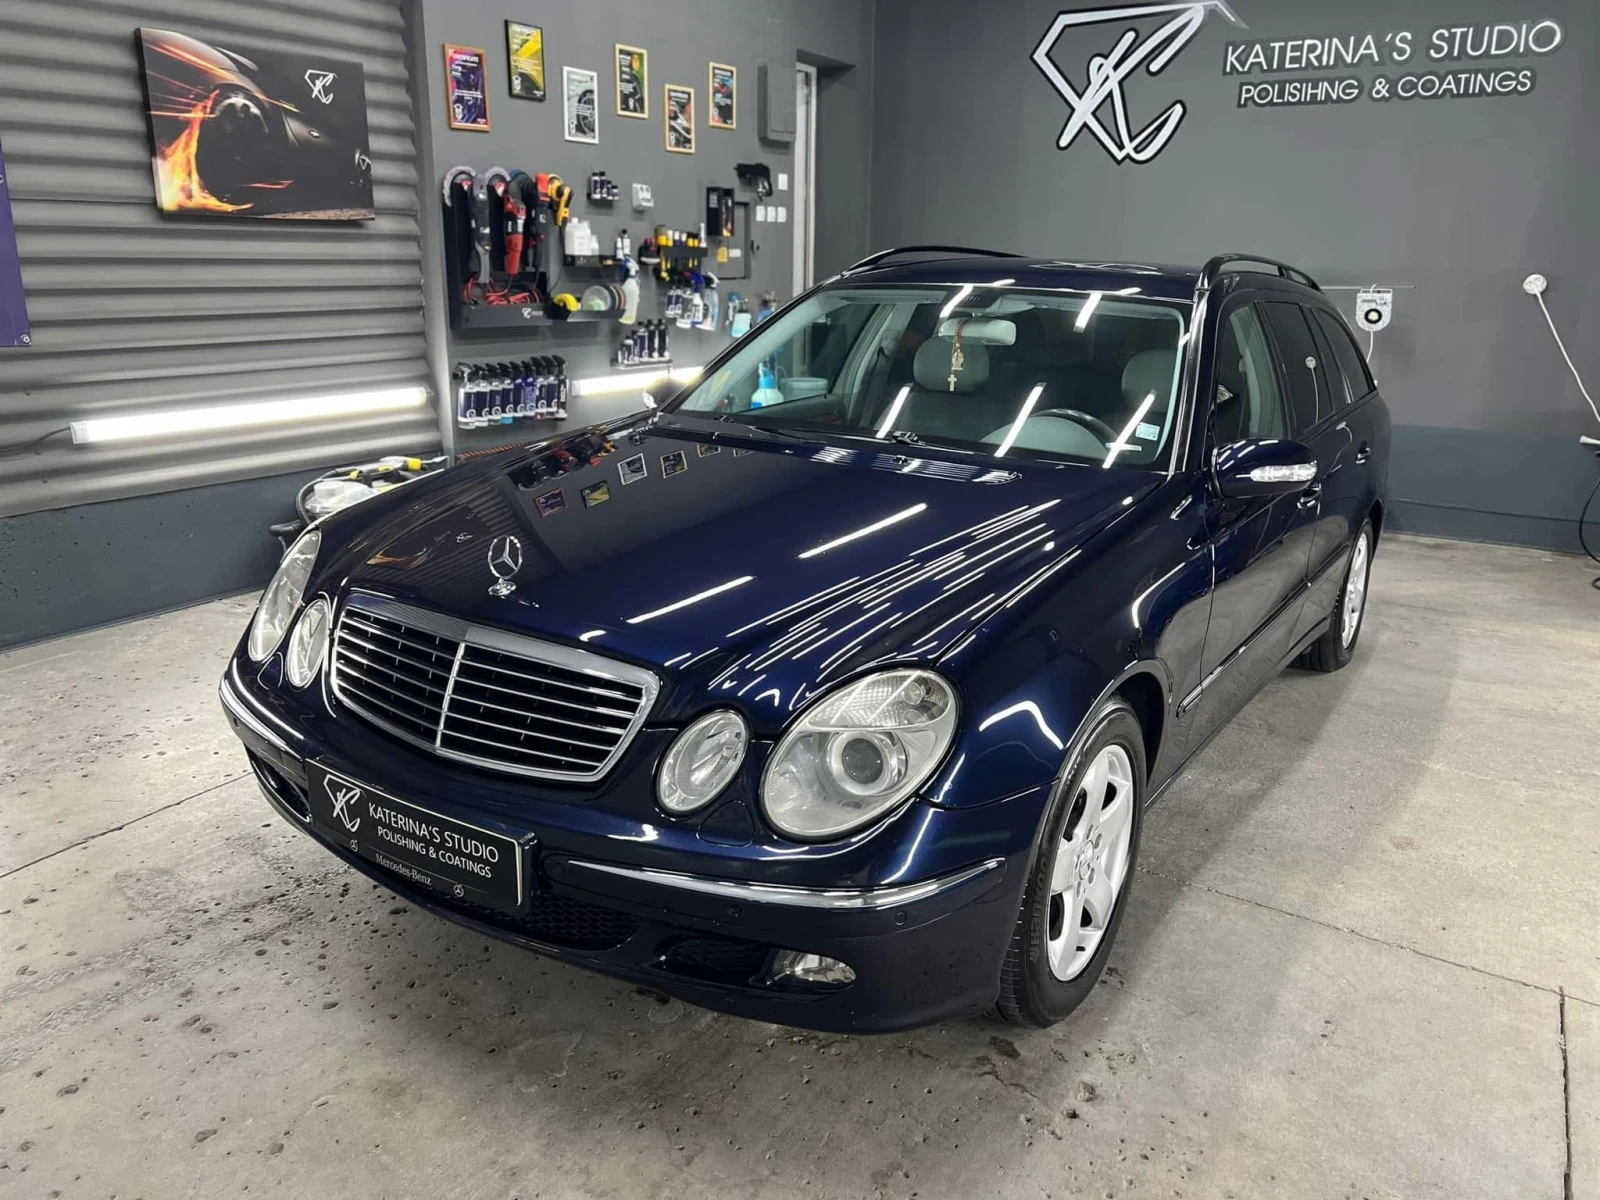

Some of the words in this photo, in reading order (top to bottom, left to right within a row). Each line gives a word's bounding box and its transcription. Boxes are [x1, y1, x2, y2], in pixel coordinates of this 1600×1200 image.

[1429, 20, 1563, 60] STUDIO
[1241, 80, 1359, 106] POLISIHNG
[1373, 82, 1390, 98] &
[1398, 71, 1532, 98] COATINGS
[368, 802, 441, 842] KATERINA'S
[444, 831, 499, 863] STUDIO
[377, 826, 427, 855] POLISHING
[428, 847, 437, 859] &
[438, 852, 492, 878] COATINGS
[375, 853, 432, 886] Mercedes-Benz
